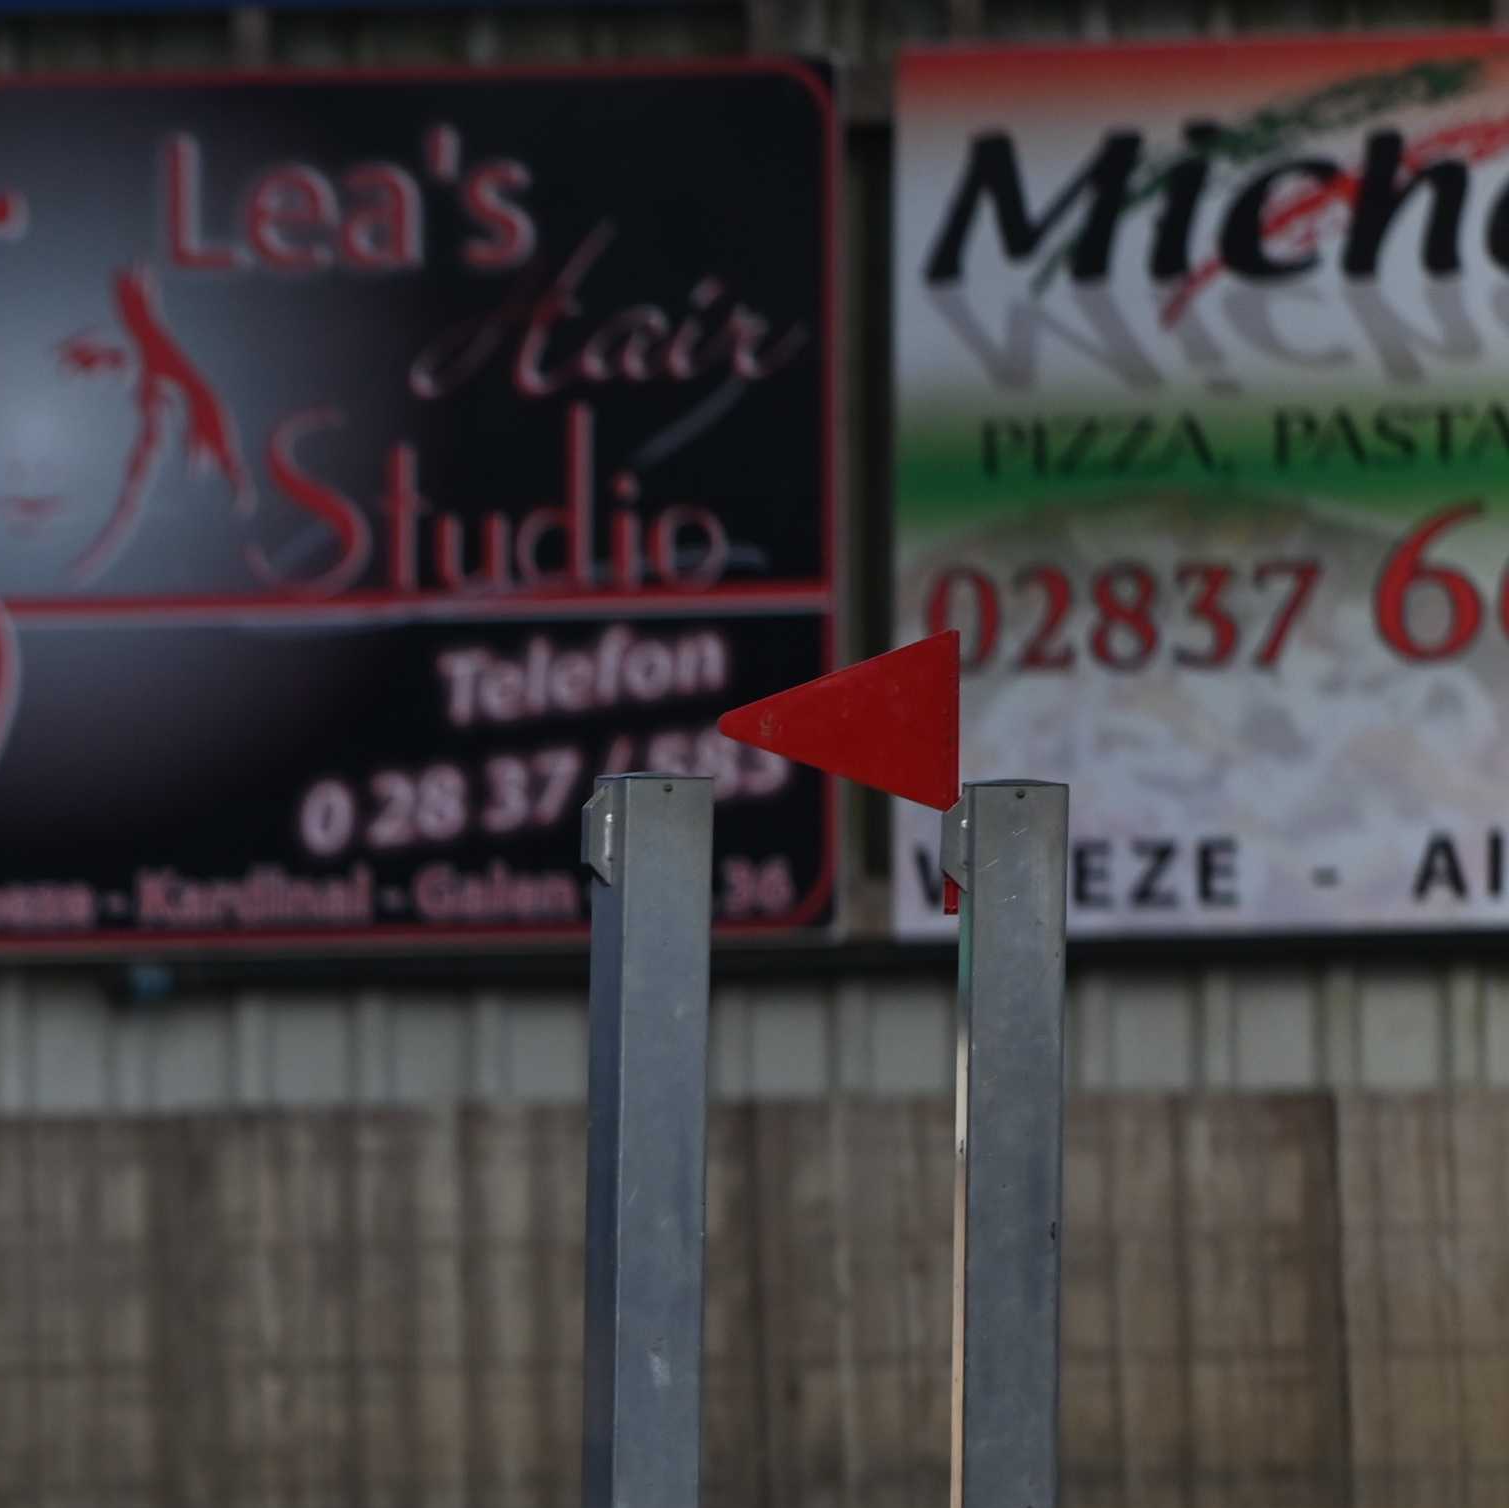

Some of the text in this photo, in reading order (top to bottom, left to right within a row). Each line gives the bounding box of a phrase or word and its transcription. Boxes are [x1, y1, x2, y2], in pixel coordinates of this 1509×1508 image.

[164, 122, 539, 272] Lea's
[923, 122, 1509, 284] Mich
[409, 218, 806, 398] Hair
[246, 402, 731, 597] Studio
[981, 410, 1239, 482] PIZZA,
[926, 495, 1509, 674] 02837 6
[438, 624, 729, 728] Telefon
[300, 780, 355, 857] 0
[367, 764, 468, 848] 28
[483, 745, 581, 832] 37
[913, 832, 1239, 910] EZE
